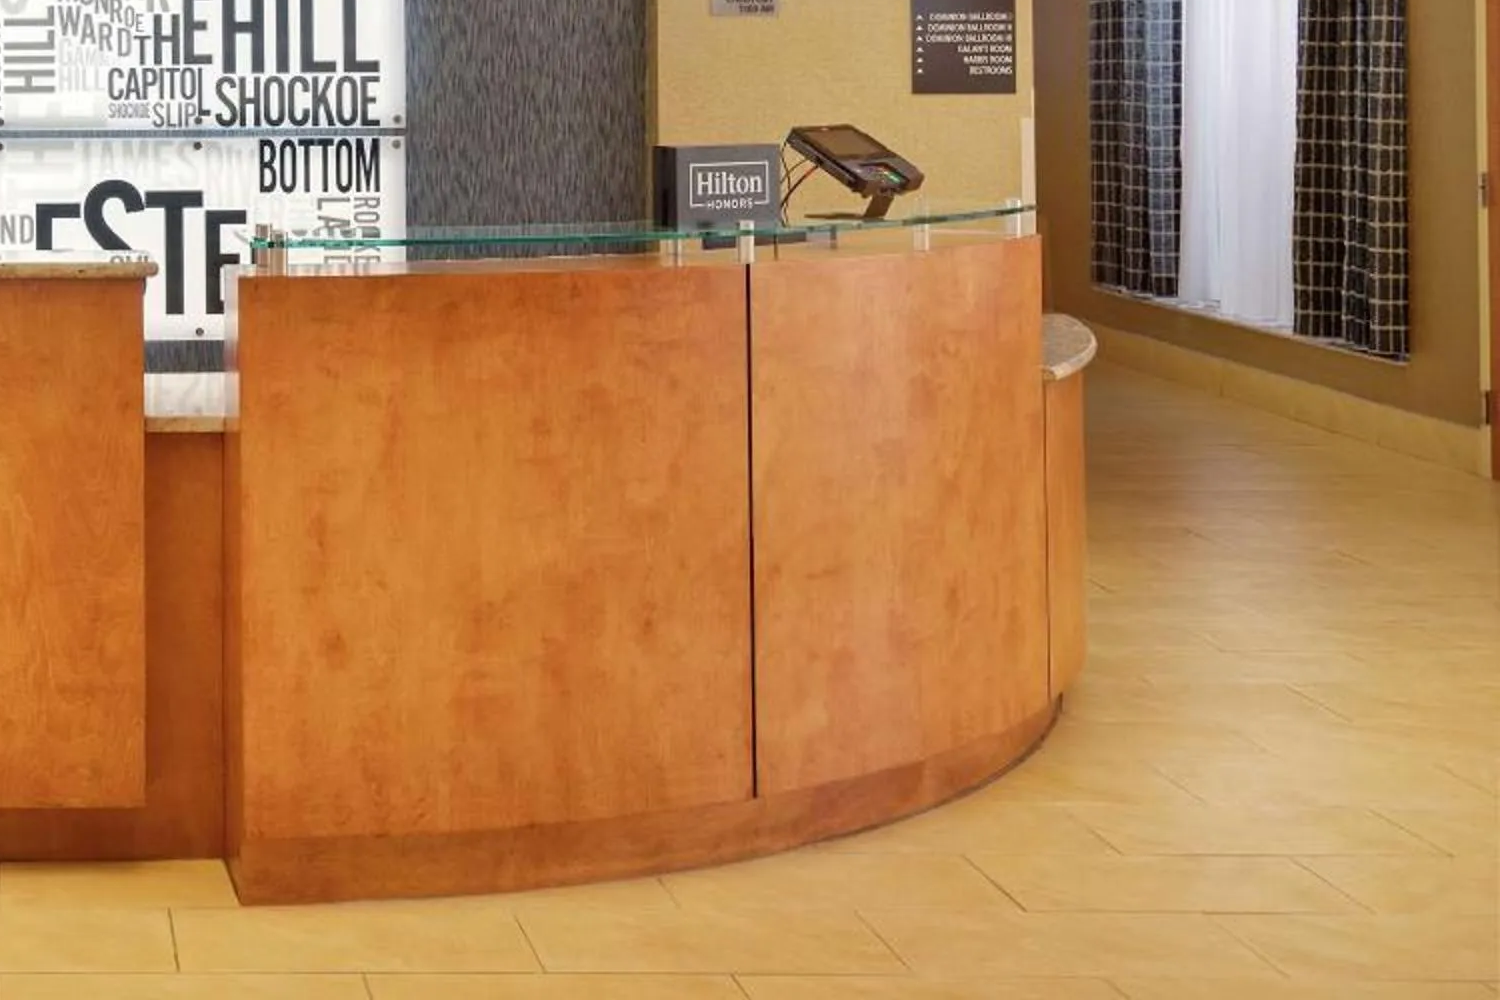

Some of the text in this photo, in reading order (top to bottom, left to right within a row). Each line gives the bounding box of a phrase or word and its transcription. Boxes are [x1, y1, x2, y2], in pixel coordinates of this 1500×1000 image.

[4, 6, 54, 94] HILL
[58, 6, 131, 56] WARD
[60, 67, 105, 92] HILL
[152, 103, 197, 128] SLIP
[216, 76, 380, 127] SHOCKOE
[259, 139, 380, 193] BOTTOM
[696, 170, 763, 196] Hilton
[707, 198, 754, 209] HONORS
